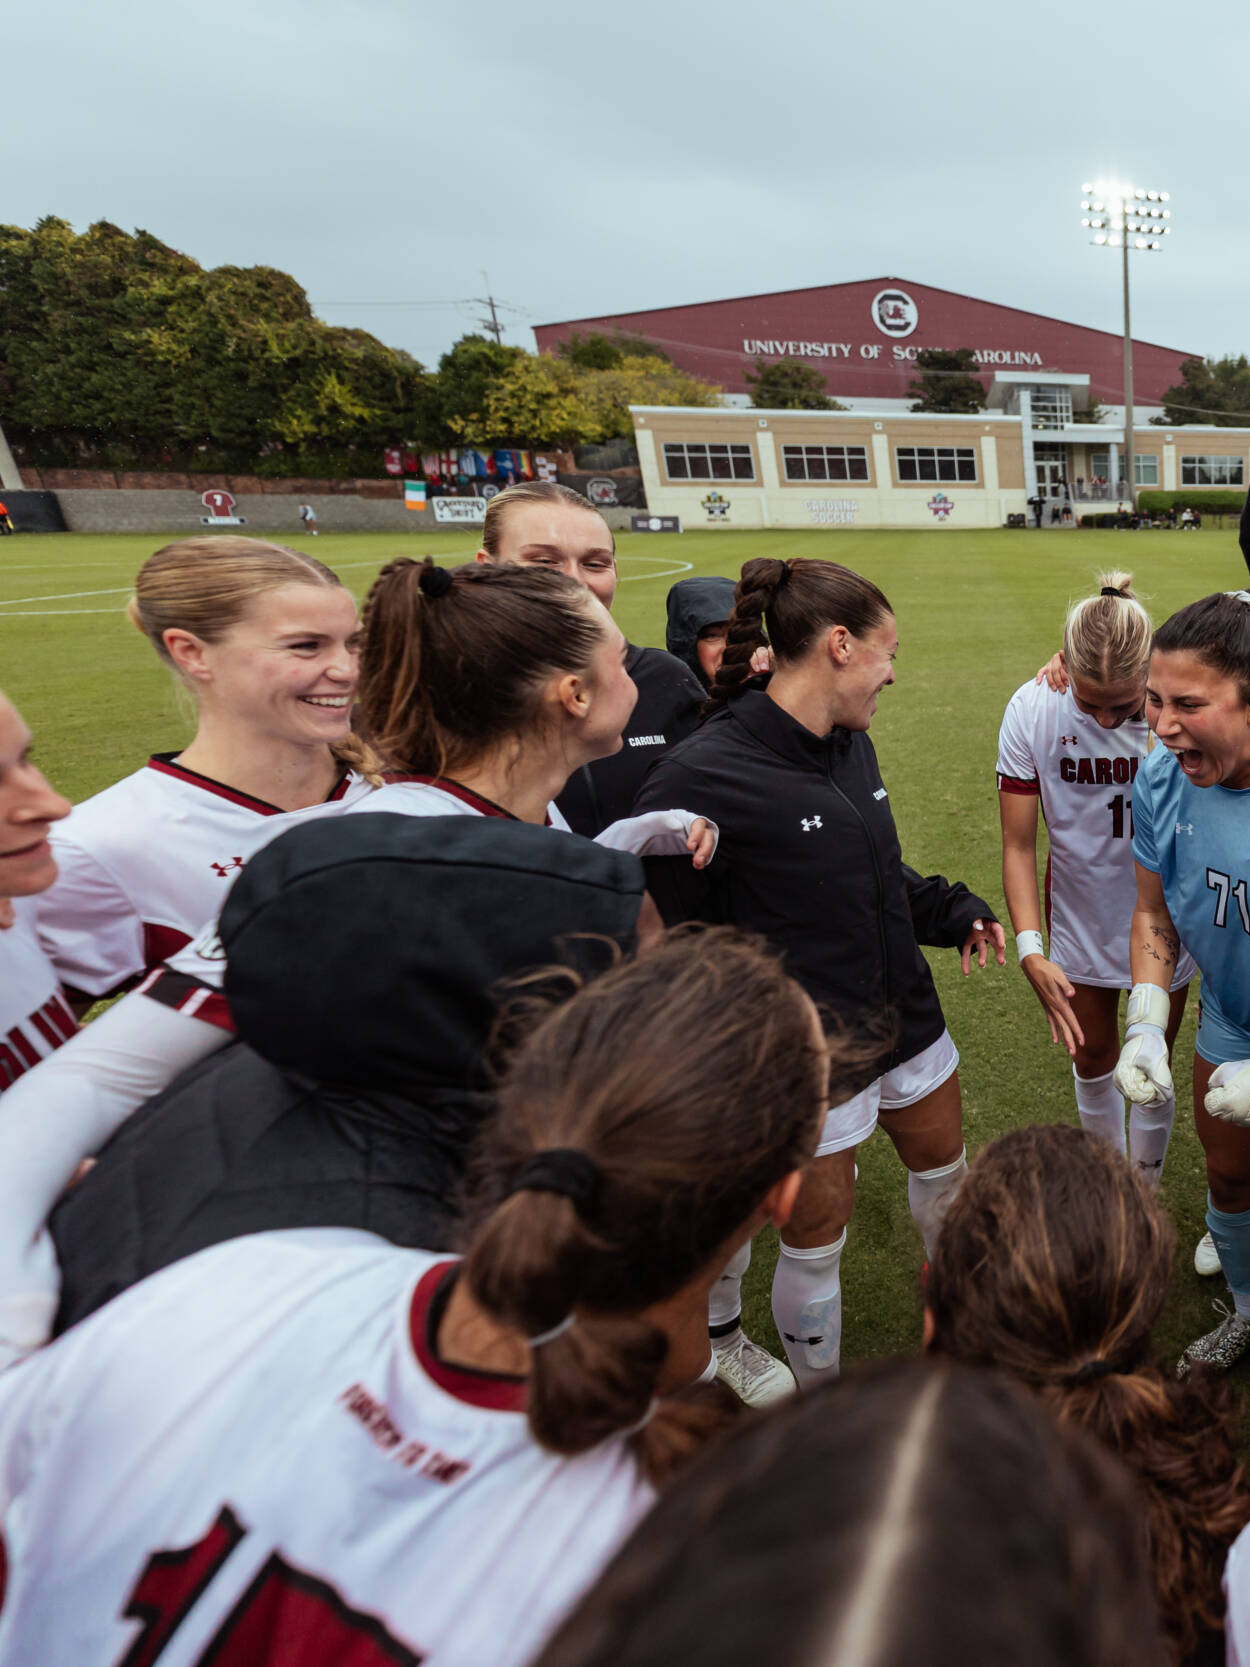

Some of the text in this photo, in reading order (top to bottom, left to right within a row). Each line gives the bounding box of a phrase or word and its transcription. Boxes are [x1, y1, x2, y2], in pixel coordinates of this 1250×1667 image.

[743, 339, 851, 358] UNIVERSITY
[860, 343, 883, 359] OF
[972, 349, 1043, 366] AROLINA
[804, 499, 858, 512] CAROLINA
[628, 734, 667, 747] CAROLINA
[1060, 757, 1145, 784] CAROL
